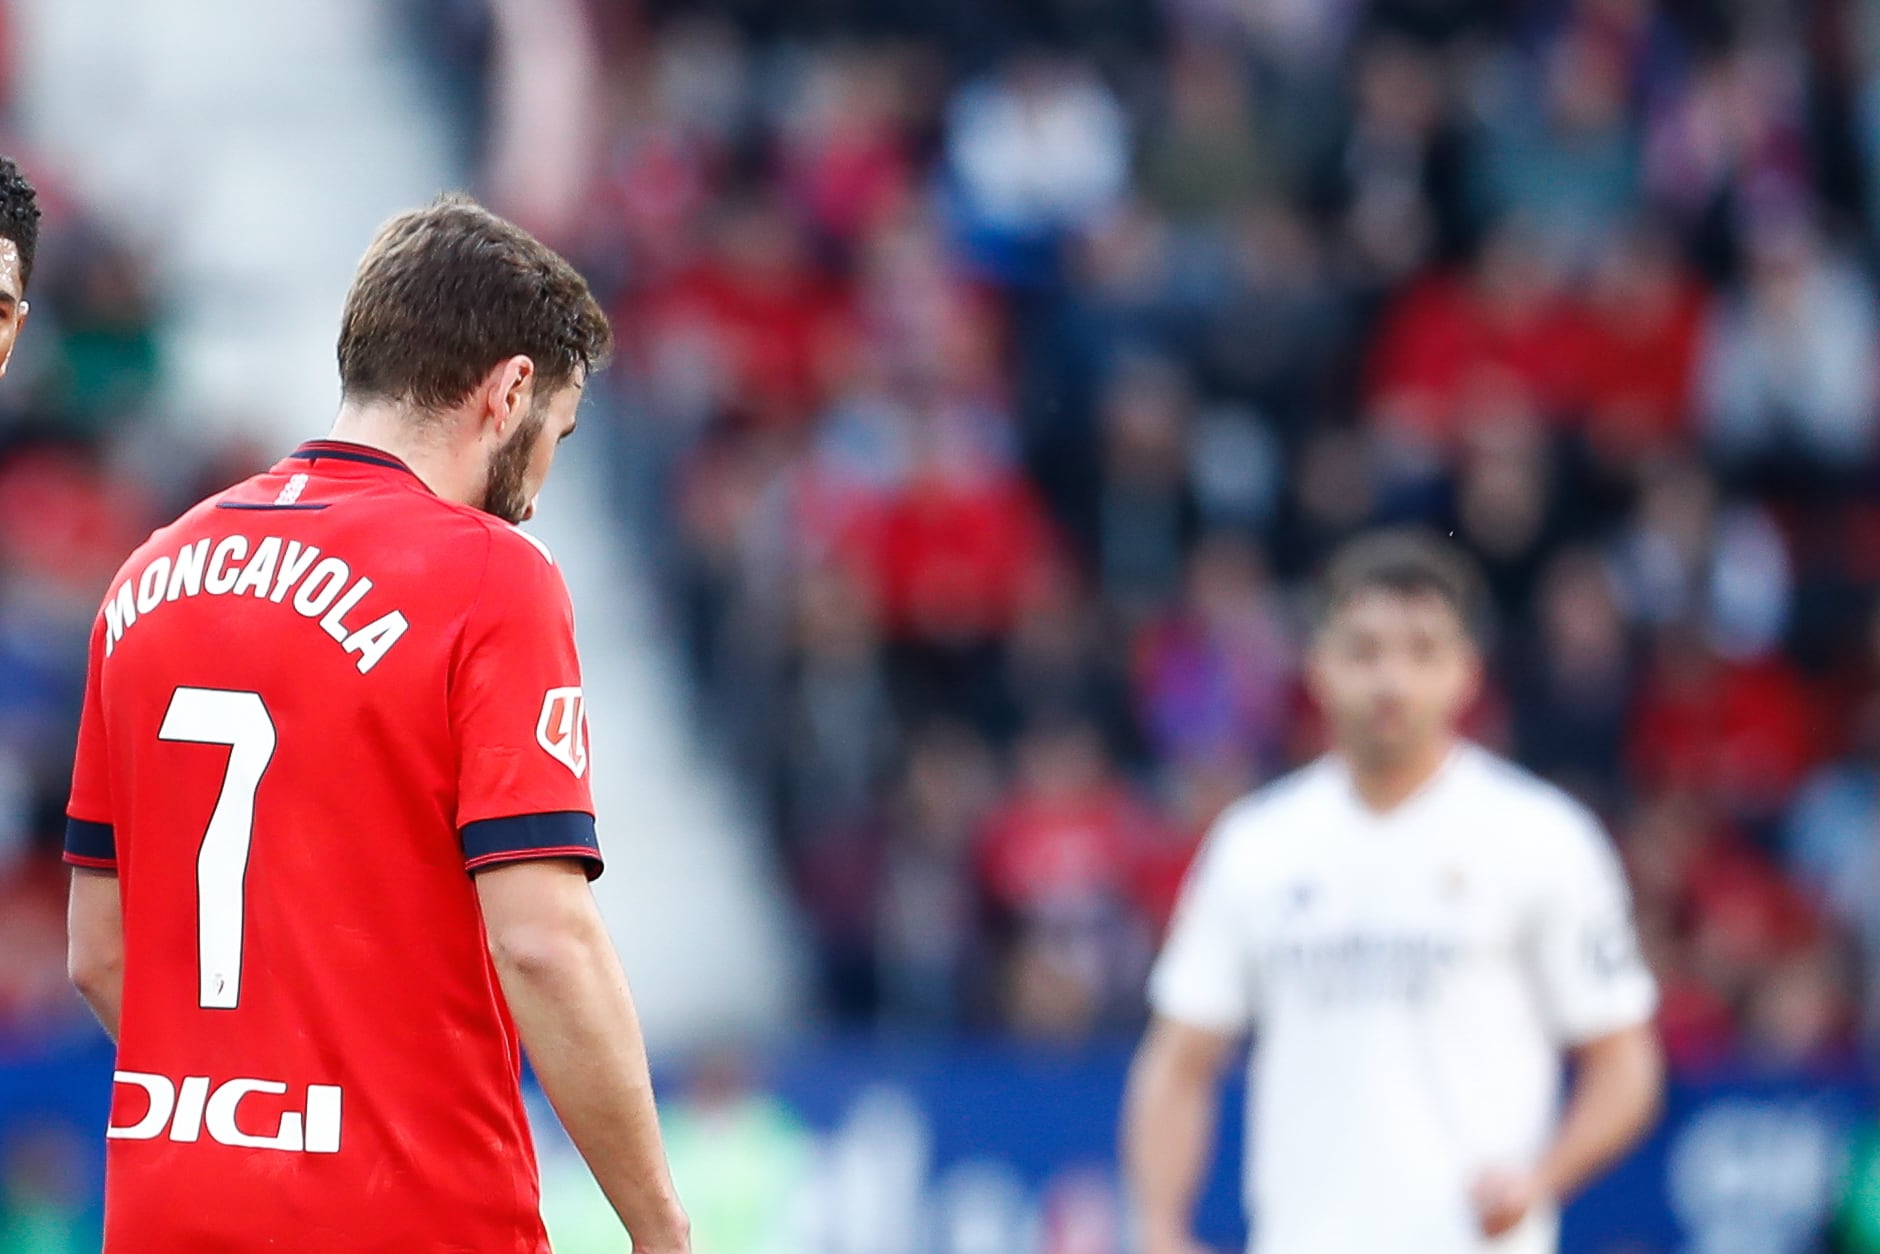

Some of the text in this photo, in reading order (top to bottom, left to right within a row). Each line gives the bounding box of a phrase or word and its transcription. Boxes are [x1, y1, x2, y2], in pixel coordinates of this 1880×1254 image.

[105, 535, 410, 674] MONCAYOLA
[158, 685, 277, 1009] 7
[106, 1070, 342, 1153] DIGI
